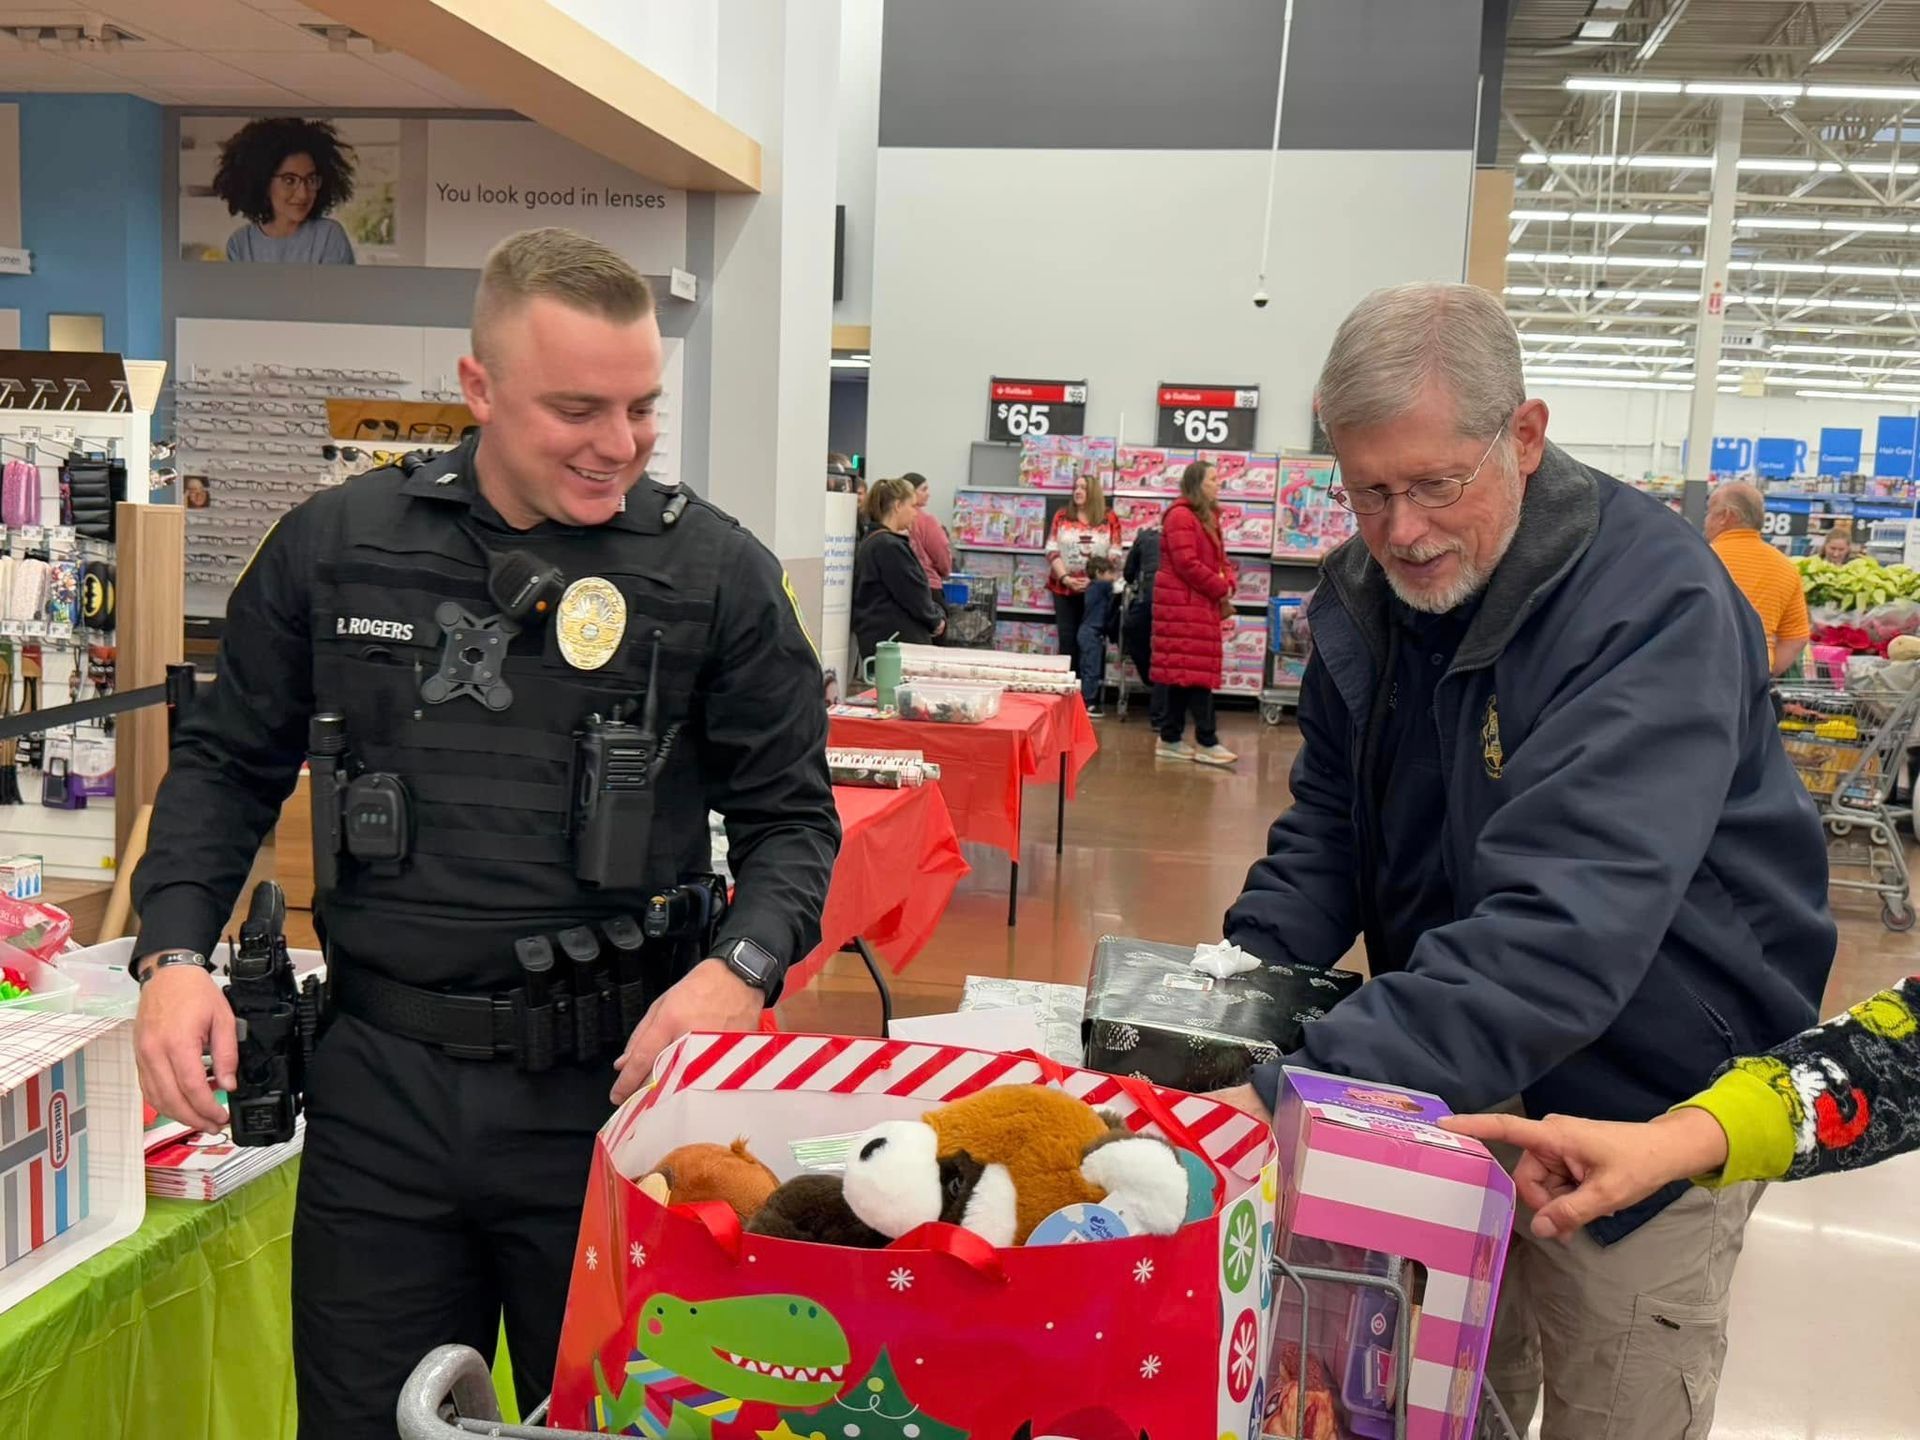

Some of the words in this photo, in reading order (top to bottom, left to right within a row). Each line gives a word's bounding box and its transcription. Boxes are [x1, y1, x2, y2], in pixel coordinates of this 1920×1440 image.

[436, 183, 471, 202] You
[477, 184, 519, 205] look
[525, 187, 575, 210] good
[581, 187, 598, 206] in
[604, 188, 666, 209] lenses
[997, 403, 1050, 436] $65
[1173, 409, 1229, 443] $65
[1895, 446, 1913, 456] Care
[54, 1100, 63, 1129] little
[55, 1129, 65, 1160] tikes
